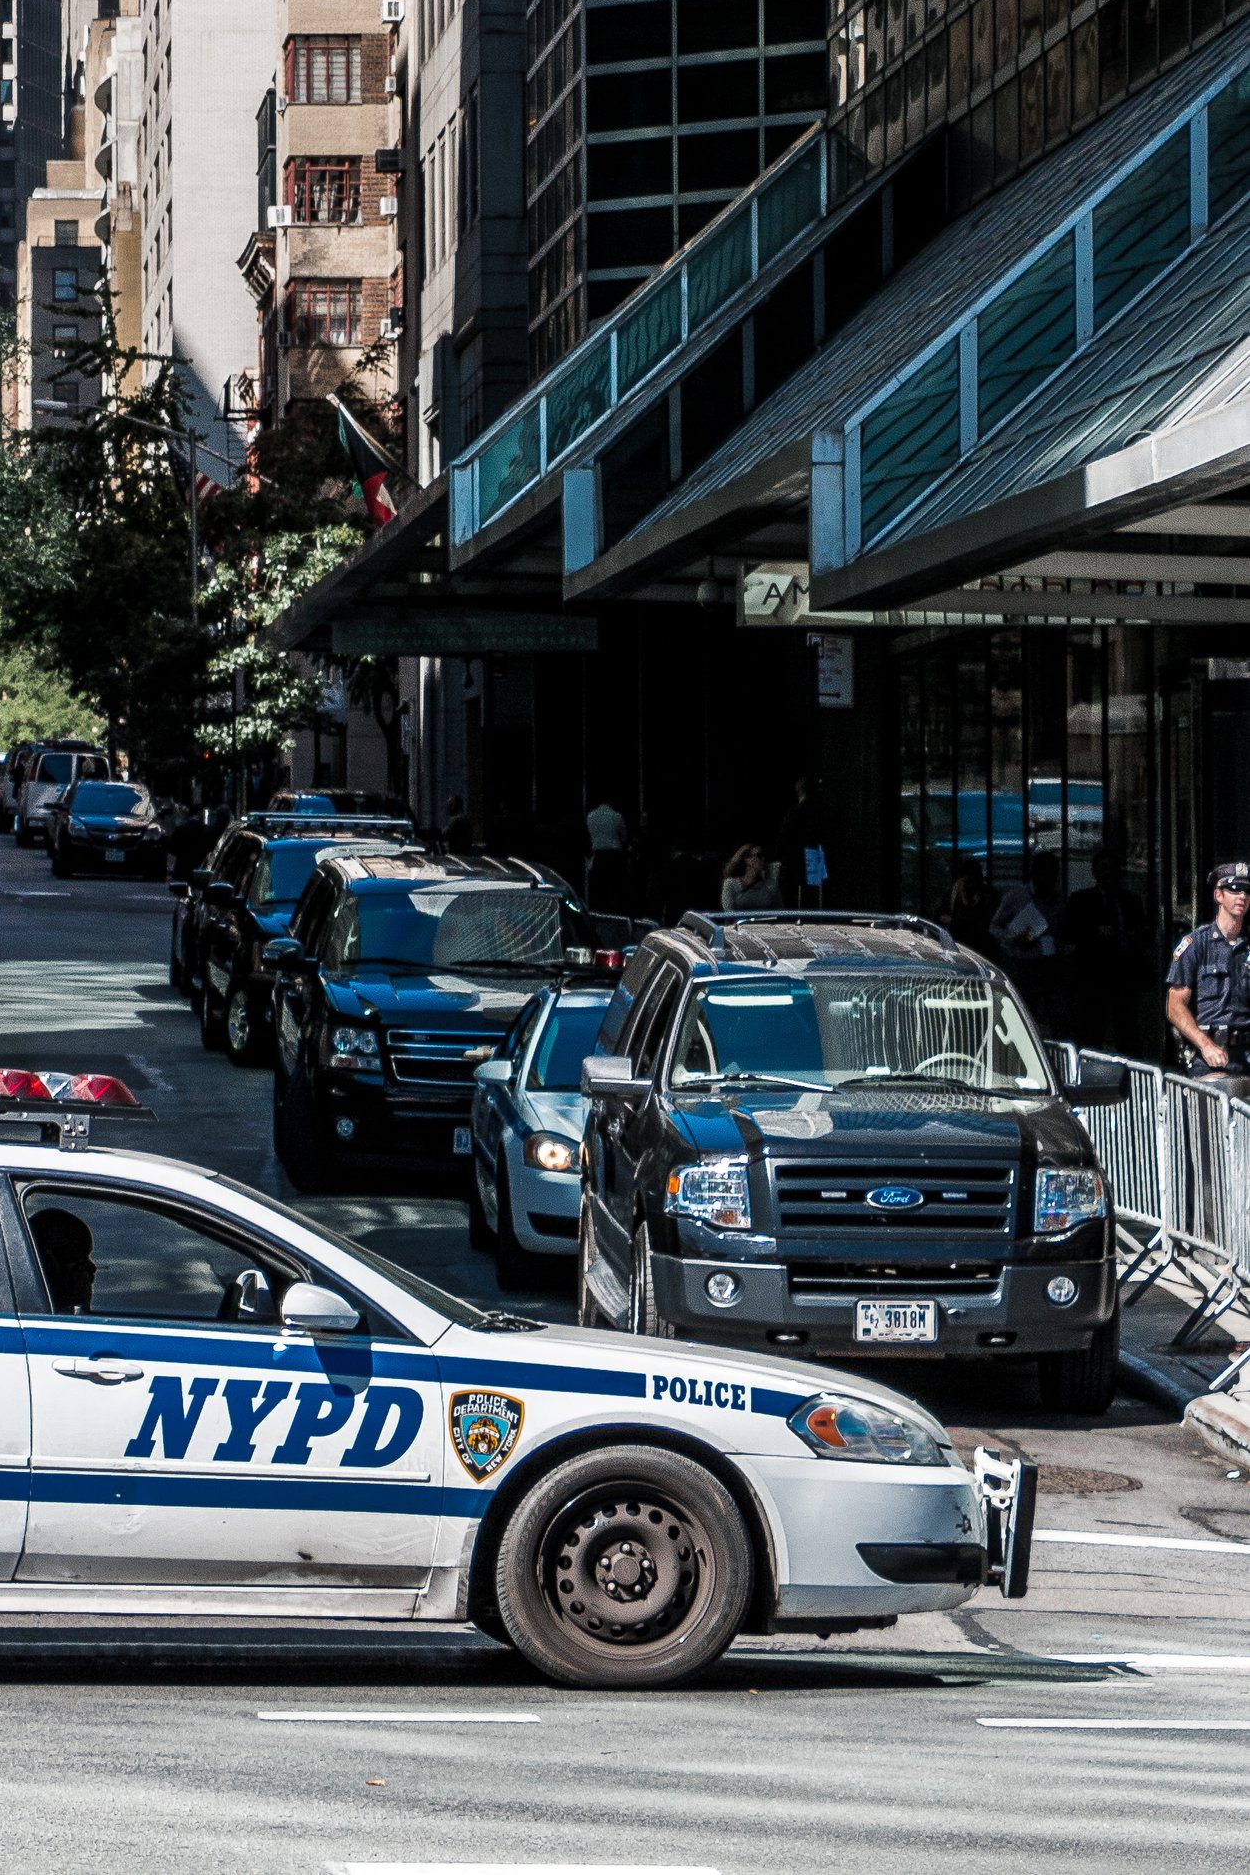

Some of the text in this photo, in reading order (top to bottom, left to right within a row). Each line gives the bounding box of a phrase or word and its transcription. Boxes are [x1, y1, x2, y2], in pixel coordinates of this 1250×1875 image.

[880, 1190, 910, 1204] Ford
[885, 1309, 926, 1329] 3818M
[468, 1393, 508, 1409] POLICE
[652, 1375, 747, 1411] POLICE
[124, 1375, 424, 1468] NYPD
[453, 1404, 519, 1424] DEPARTMENT
[452, 1426, 473, 1465] CITY OF
[485, 1428, 517, 1473] NEW YORK
